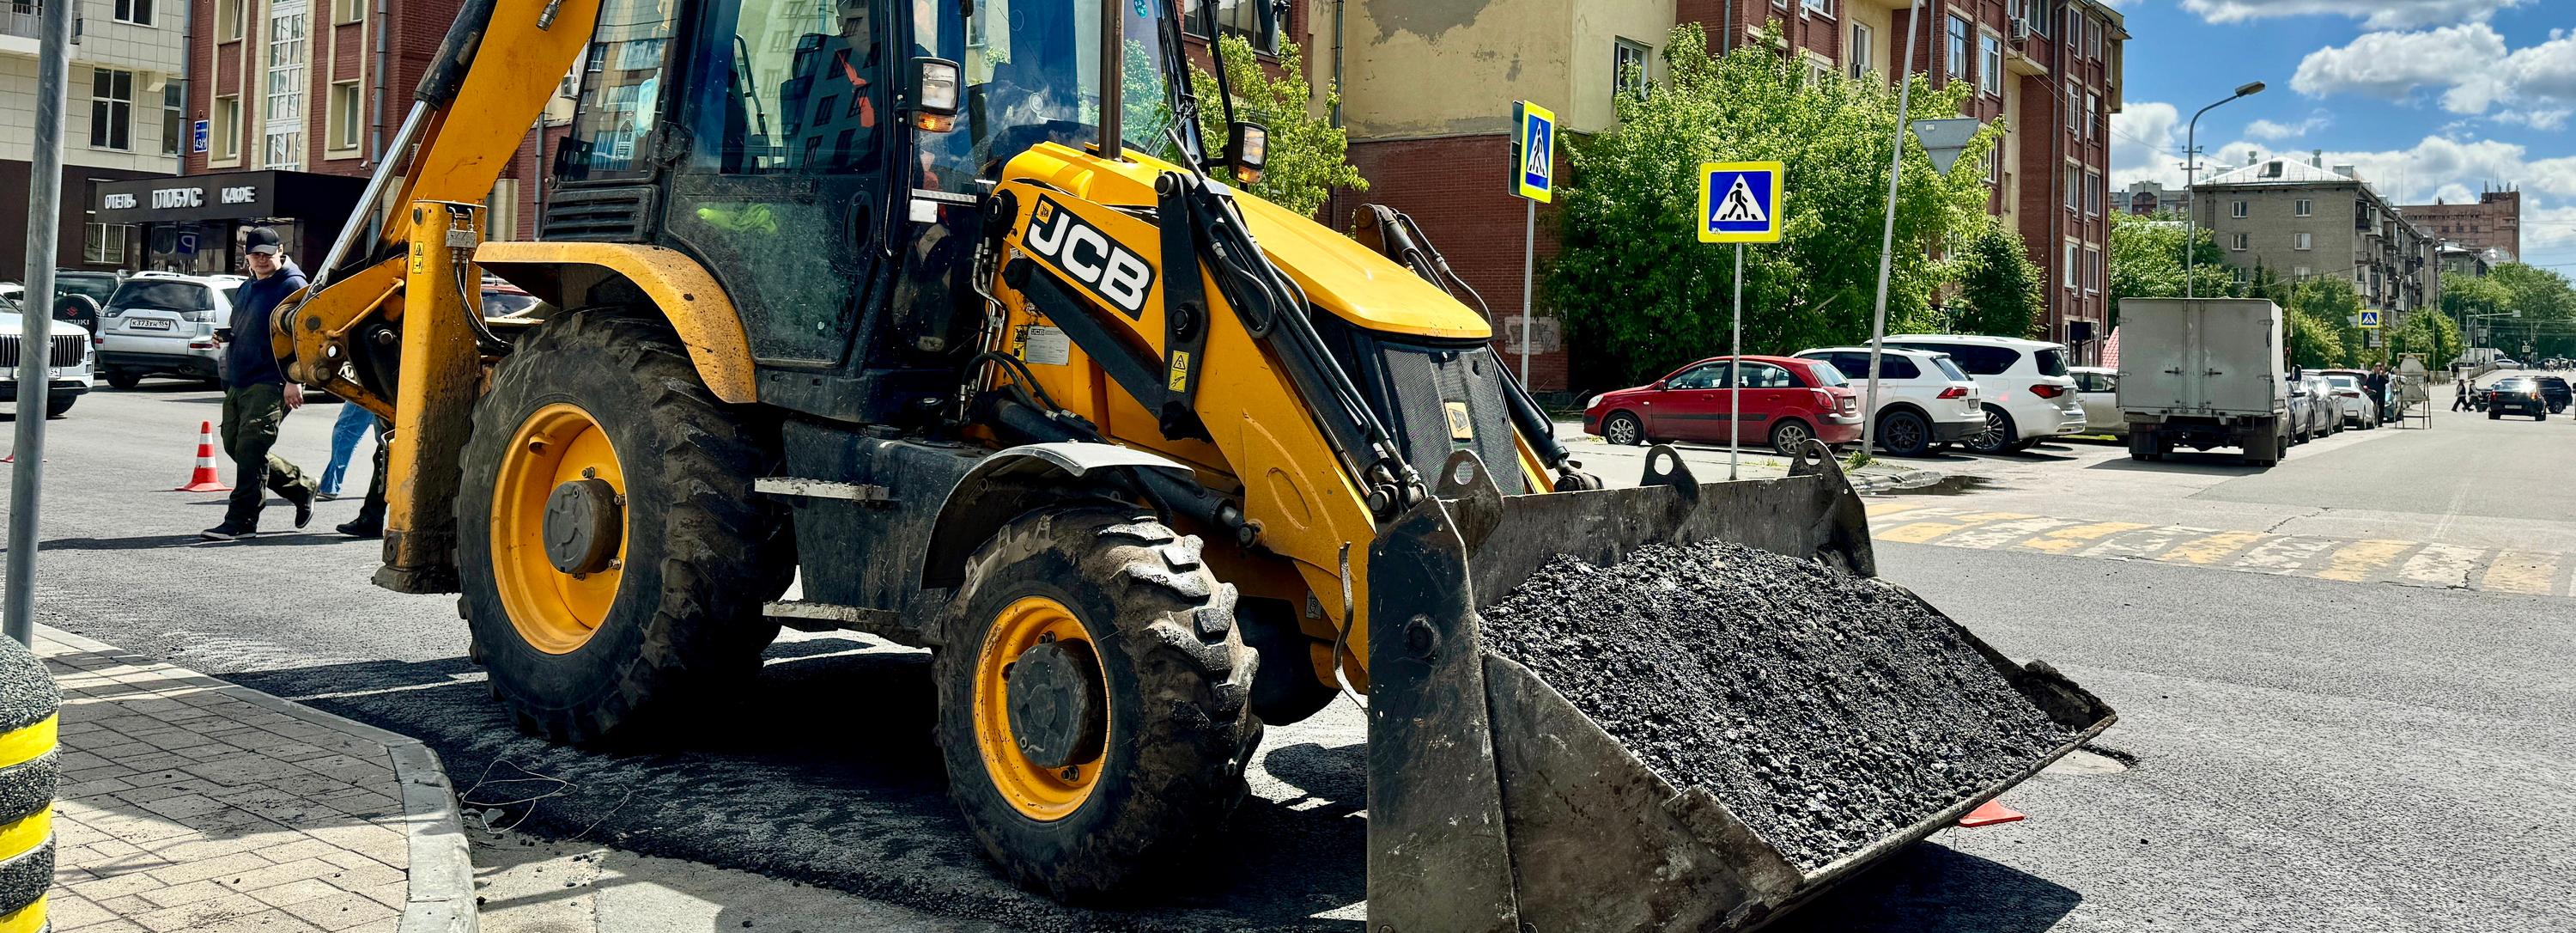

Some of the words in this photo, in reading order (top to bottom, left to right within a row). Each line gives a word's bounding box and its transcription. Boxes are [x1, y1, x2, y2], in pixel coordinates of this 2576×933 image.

[105, 193, 137, 209] ОТЕЛЬ
[152, 187, 204, 209] ГЛОБУС
[222, 186, 255, 204] КАФЕ
[1028, 211, 1150, 311] JCB
